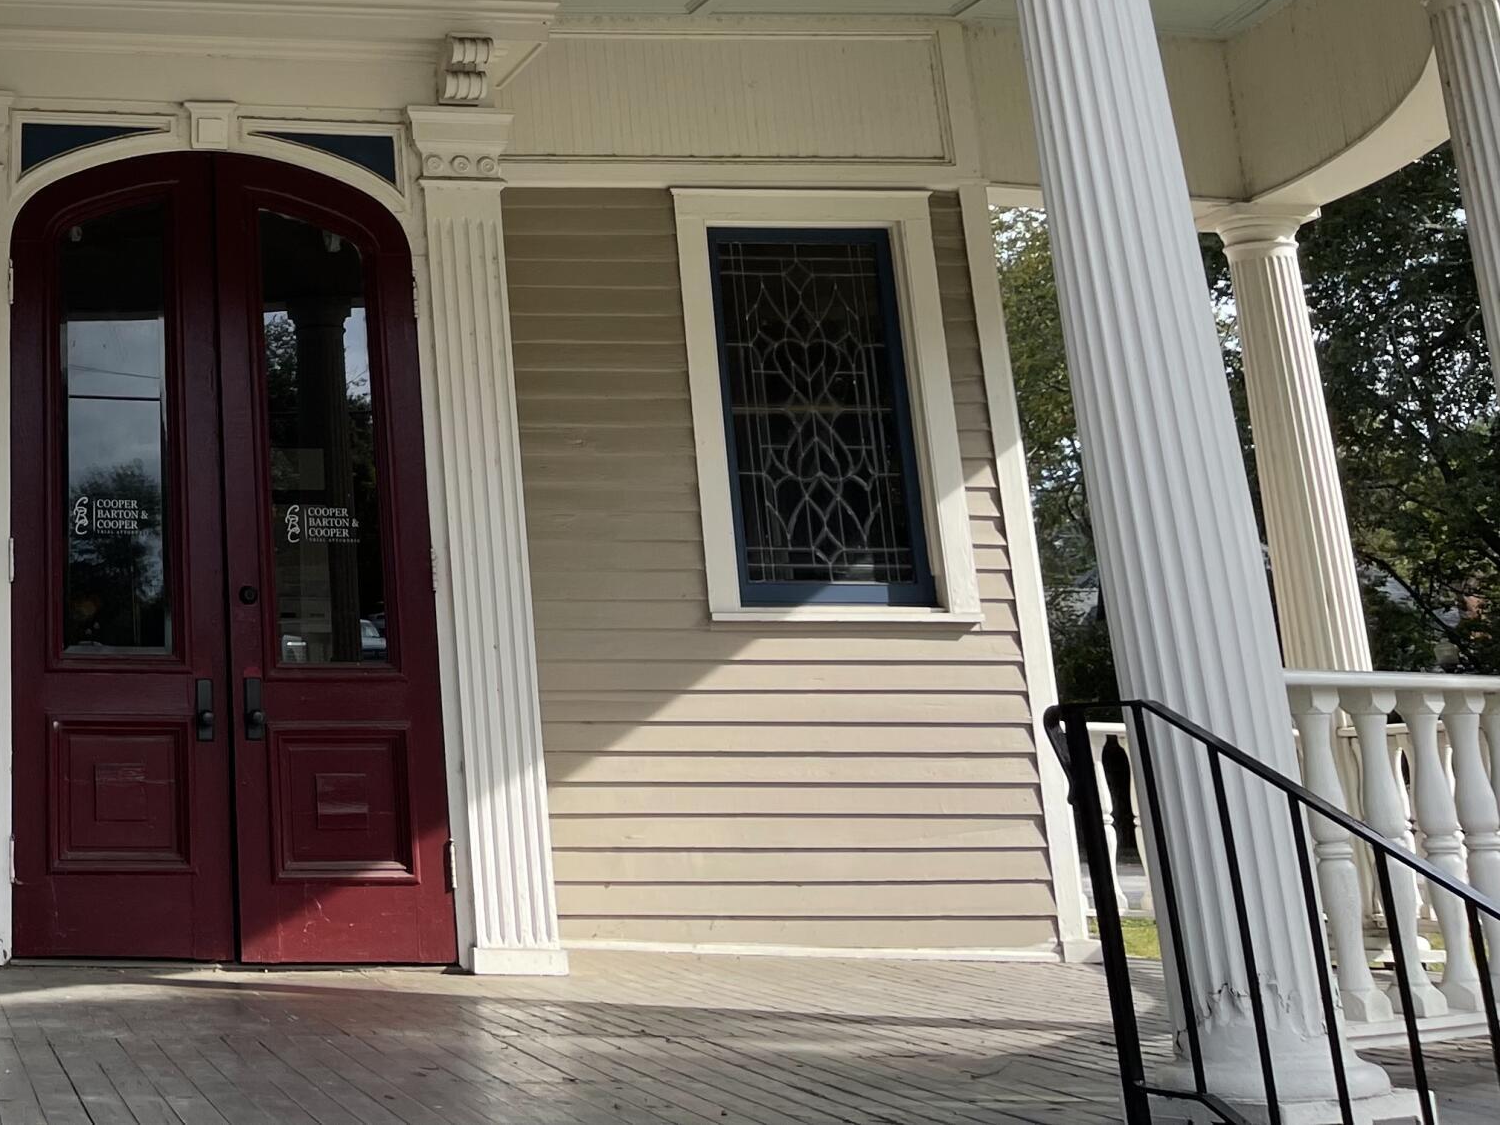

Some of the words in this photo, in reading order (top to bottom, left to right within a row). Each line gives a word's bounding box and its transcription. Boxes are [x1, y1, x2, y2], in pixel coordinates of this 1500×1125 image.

[97, 499, 138, 509] COOPER
[97, 509, 139, 519] BARTON
[140, 510, 149, 520] &
[308, 507, 349, 517] COOPER
[97, 519, 138, 529] COOPER
[309, 517, 350, 527] BARTON
[351, 518, 359, 528] &
[309, 527, 350, 537] COOPER
